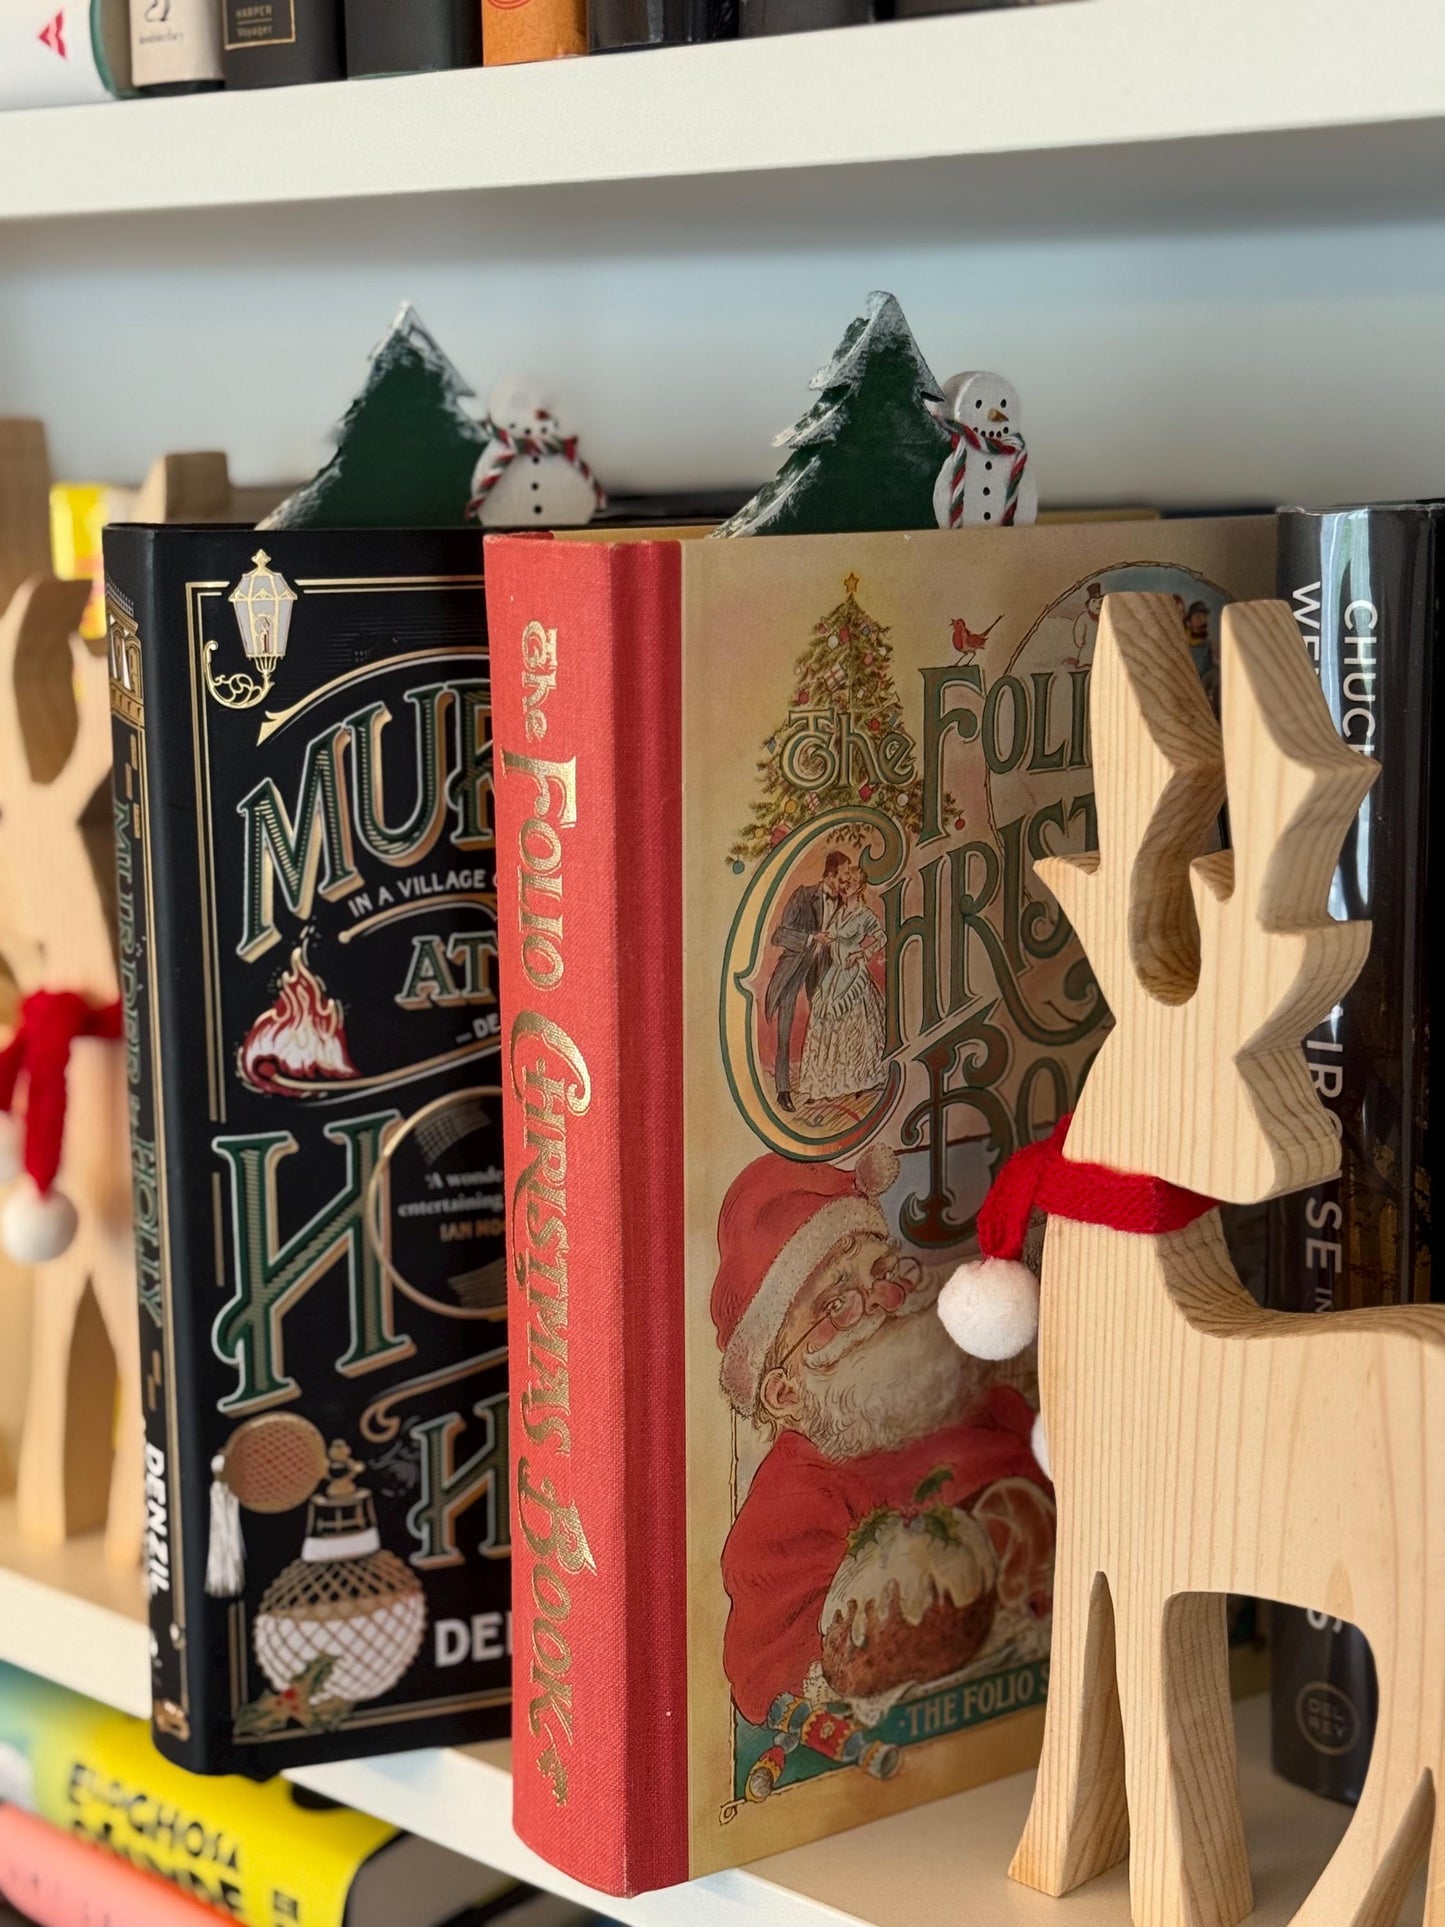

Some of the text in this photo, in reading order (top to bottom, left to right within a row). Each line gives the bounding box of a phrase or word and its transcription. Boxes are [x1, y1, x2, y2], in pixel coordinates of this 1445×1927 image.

[235, 5, 273, 18] HARPER
[236, 25, 273, 38] Voyager
[521, 619, 558, 743] The
[780, 665, 1093, 847] The FOLI
[236, 678, 496, 963] MUR
[348, 893, 373, 918] IN
[378, 886, 394, 906] A
[396, 869, 486, 898] VILLAGE
[394, 930, 498, 1011] AT
[472, 1013, 499, 1039] DE
[446, 1165, 504, 1187] wonde
[509, 1009, 591, 1457] CHRISTMAS
[145, 1442, 170, 1596] DENZIL
[517, 1455, 598, 1746] BOOK
[434, 1610, 513, 1668] DE
[906, 1690, 958, 1737] THE
[963, 1670, 1034, 1720] FOLIO
